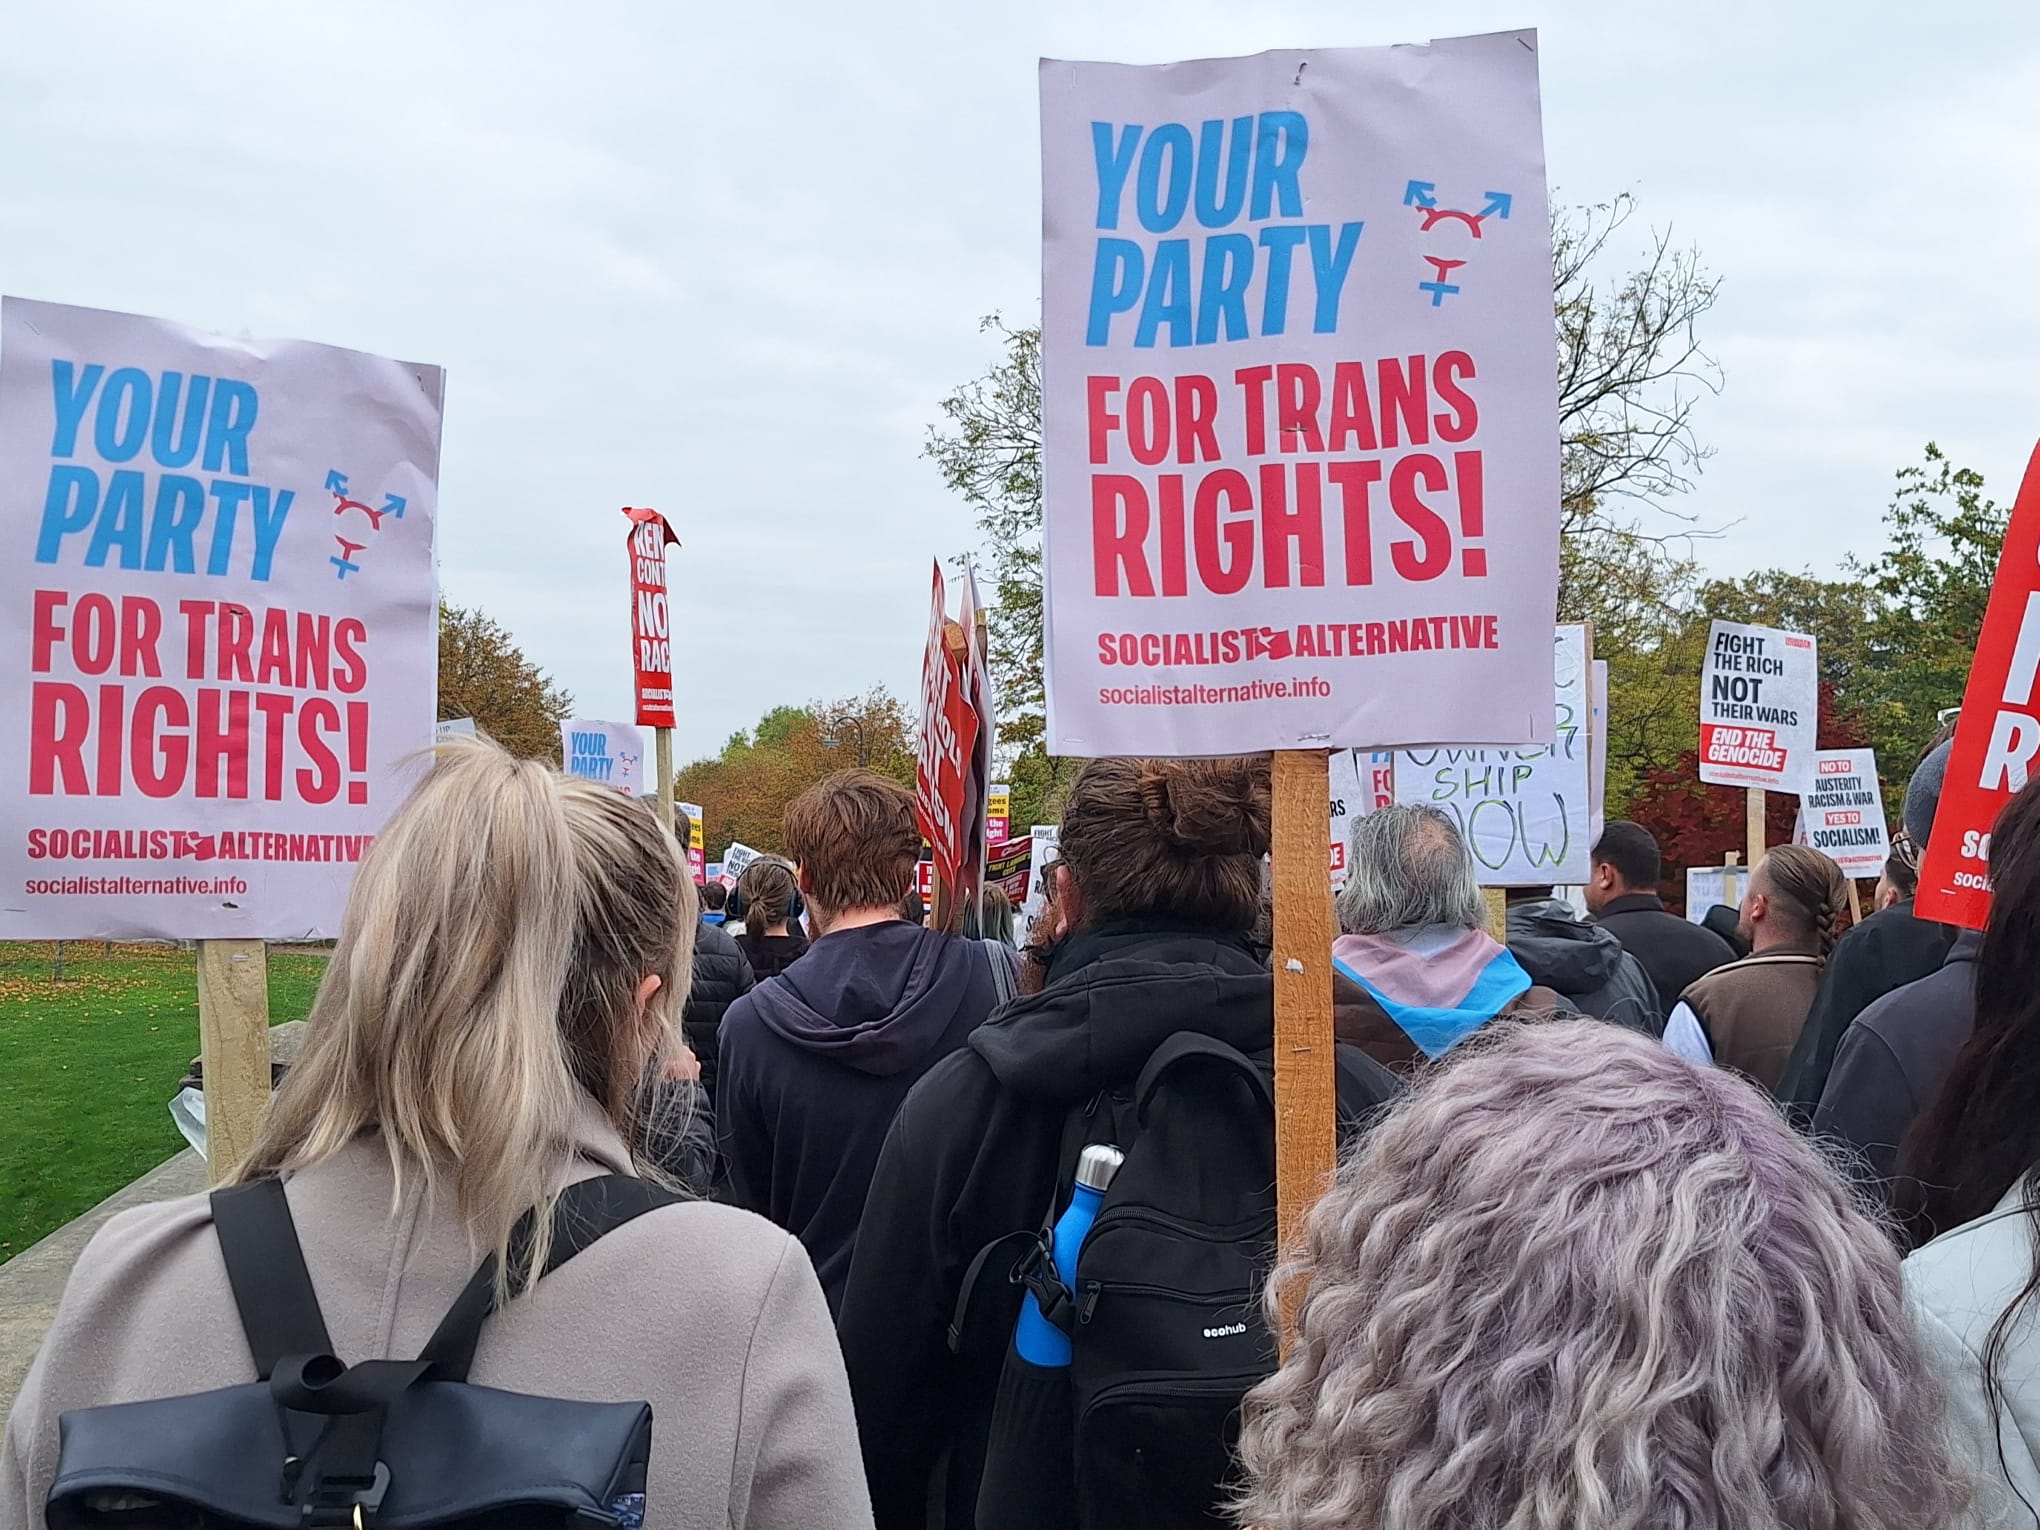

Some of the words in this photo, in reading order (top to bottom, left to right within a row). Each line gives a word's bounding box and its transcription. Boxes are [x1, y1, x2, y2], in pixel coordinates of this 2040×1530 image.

[1091, 110, 1309, 233] YOUR
[1085, 222, 1364, 349] PARTY
[50, 358, 259, 476] YOUR
[1087, 375, 1221, 464] FOR
[1235, 351, 1480, 456] TRANS
[34, 465, 296, 583] PARTY
[1091, 451, 1488, 598] RIGHTS!
[32, 590, 162, 678] FOR
[178, 600, 368, 694] TRANS
[1098, 634, 1256, 666] SOCIALIST
[1296, 616, 1499, 657] ALTERNATIVE
[1714, 632, 1765, 656] FIGHT
[1713, 652, 1742, 672] THE
[1746, 655, 1783, 677] RICH
[1100, 677, 1331, 706] socialistalternative.info
[1711, 674, 1763, 704] NOT
[1711, 701, 1754, 721] THEIR
[1756, 705, 1798, 727] WARS
[29, 682, 369, 804] RIGHTS!
[571, 731, 607, 756] YOUR
[1711, 727, 1743, 746] END
[1744, 730, 1772, 749] THE
[570, 756, 614, 780] PARTY
[1708, 744, 1783, 769] GENOCIDE
[1820, 761, 1836, 773] NO
[1836, 760, 1850, 772] TO
[1432, 765, 1533, 800] SHIP
[1815, 776, 1862, 793] AUSTERITY
[1329, 799, 1346, 818] RS
[1808, 792, 1845, 808] RACISM
[1845, 793, 1853, 806] &
[1853, 791, 1875, 806] WAR
[1826, 813, 1845, 825] YES
[1846, 812, 1859, 823] TO
[28, 829, 187, 860] SOCIALIST
[1813, 826, 1881, 849] SOCIALISM!
[727, 859, 746, 874] NOT
[26, 876, 247, 896] socialistalternative.info
[1203, 1322, 1246, 1338] ecohub
